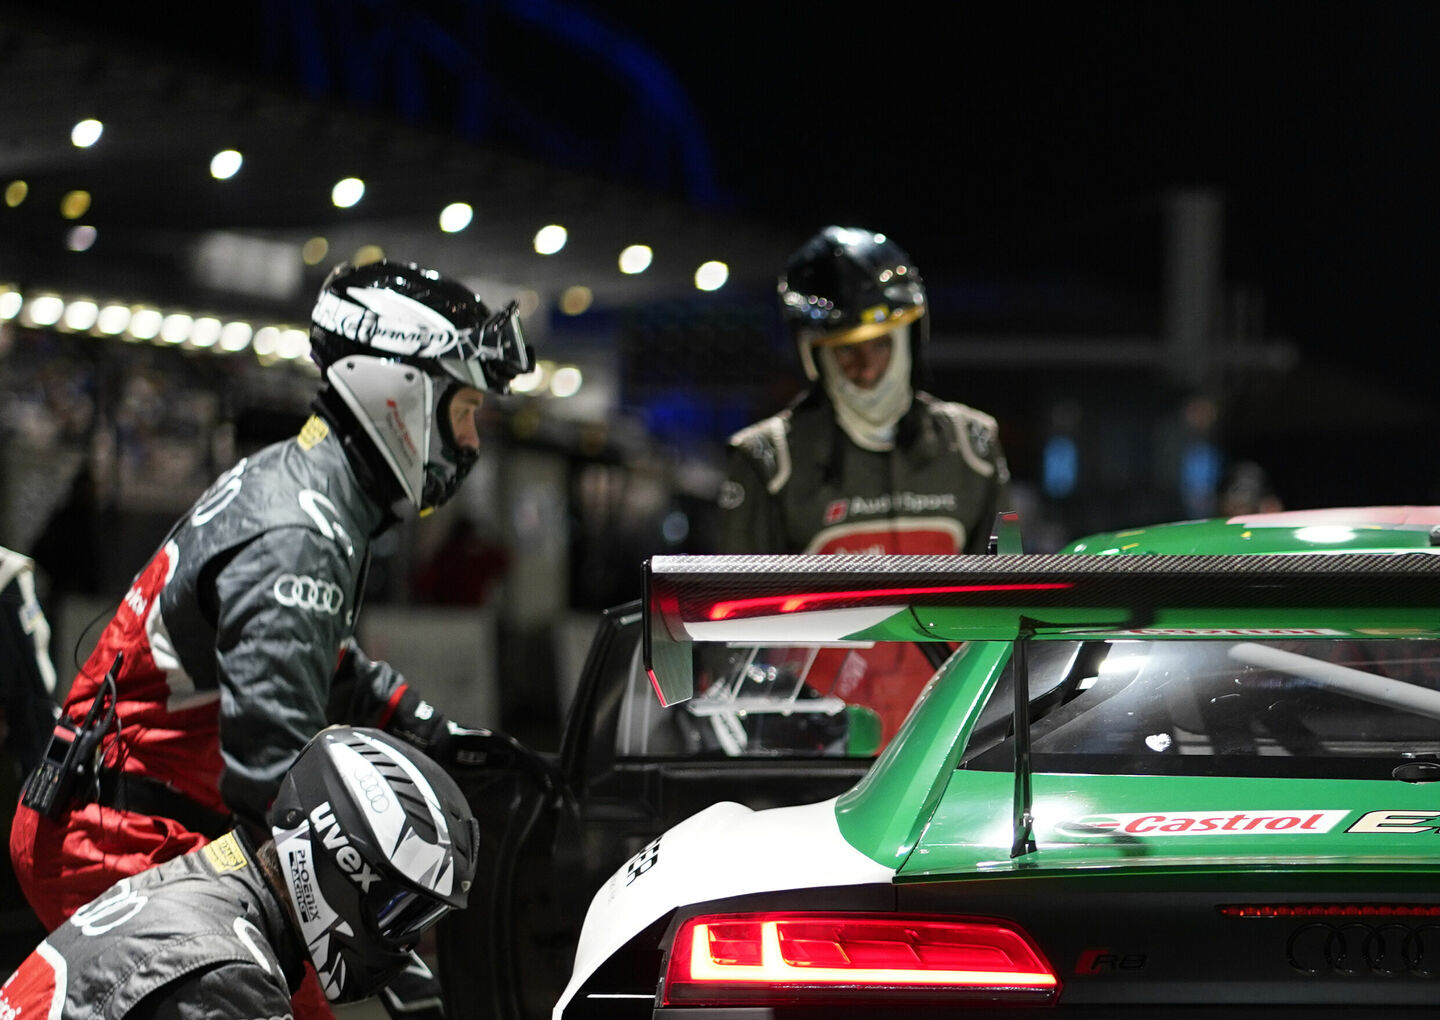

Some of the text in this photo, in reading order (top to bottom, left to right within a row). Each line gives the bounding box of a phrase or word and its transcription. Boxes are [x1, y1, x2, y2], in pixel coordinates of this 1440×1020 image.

[902, 492, 957, 515] Sport
[1124, 813, 1325, 833] Castrol
[310, 801, 382, 894] uvex
